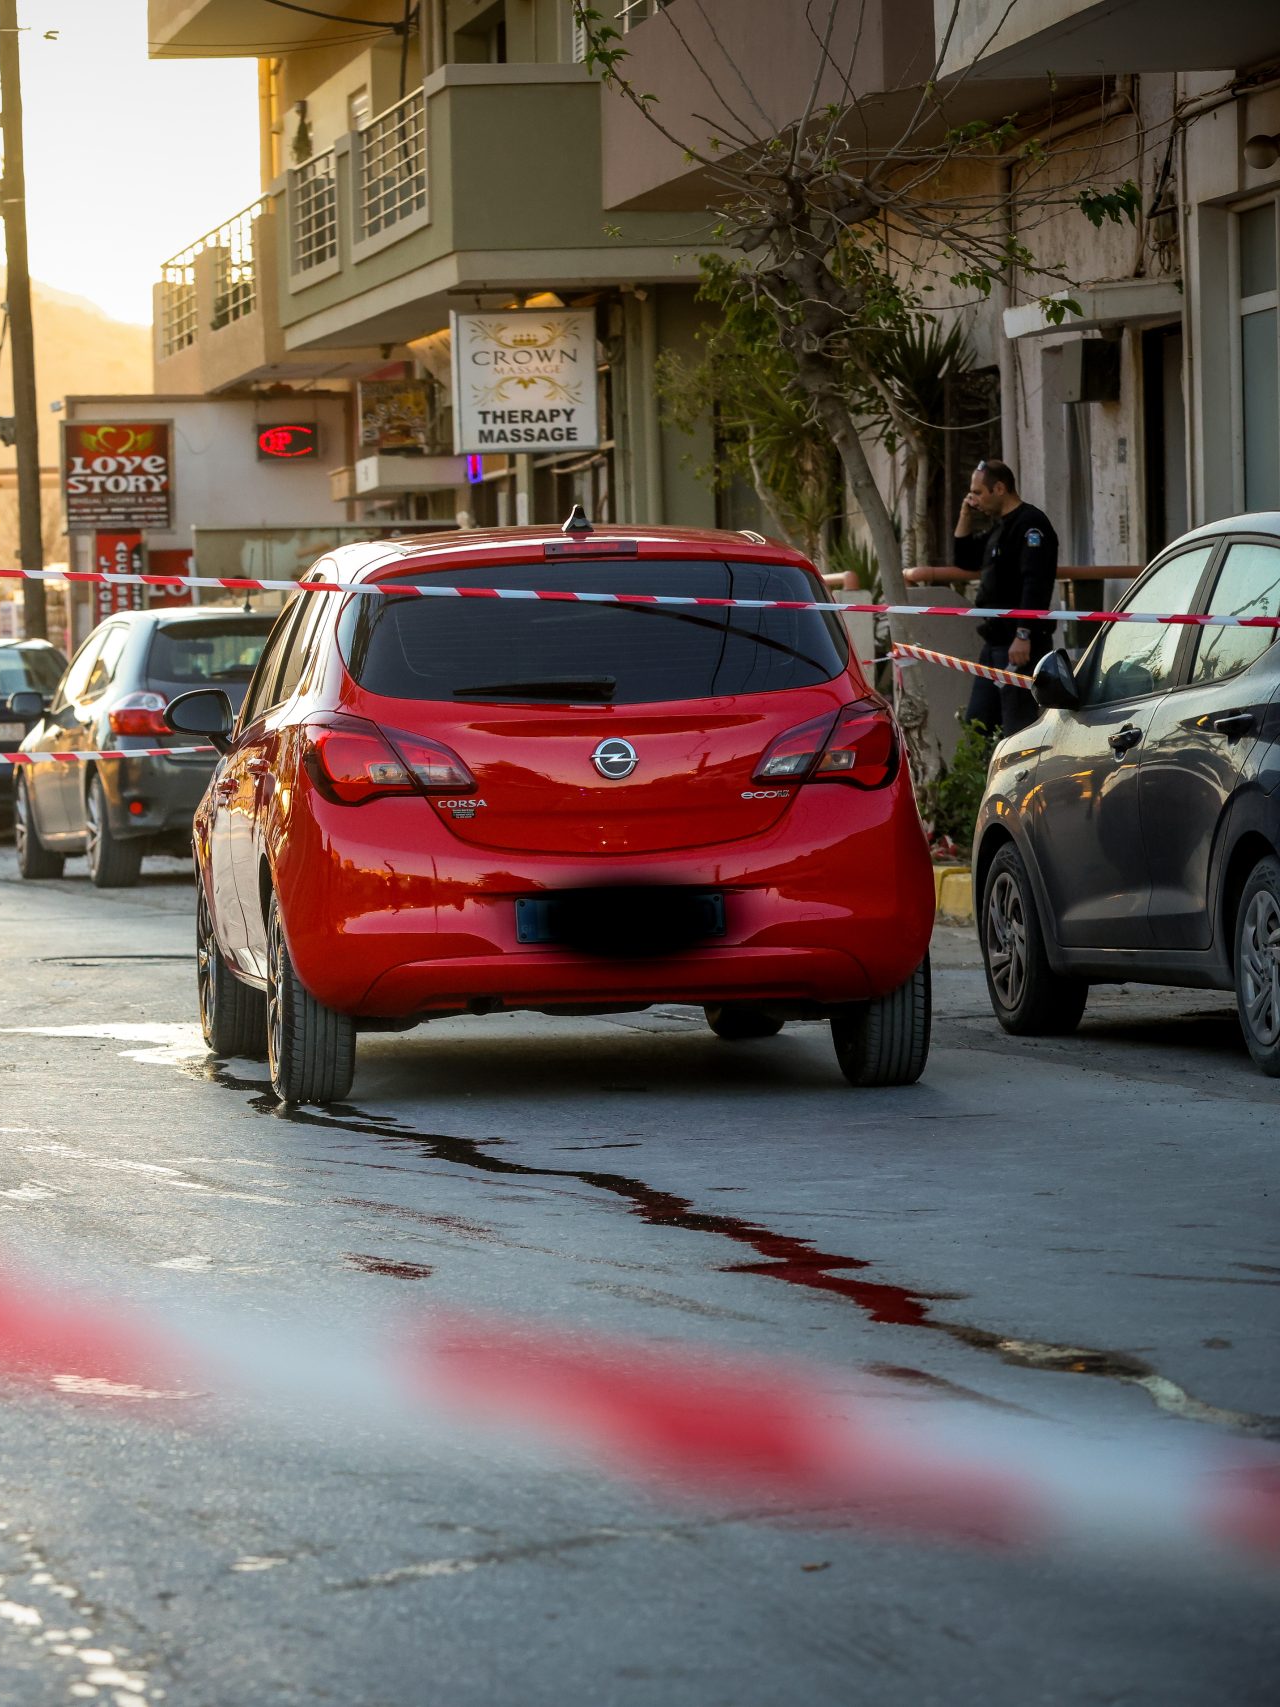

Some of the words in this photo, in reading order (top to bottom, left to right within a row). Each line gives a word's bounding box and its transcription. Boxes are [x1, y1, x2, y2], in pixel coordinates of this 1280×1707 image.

[471, 349, 577, 366] CROWN
[493, 365, 561, 375] MASSAGE
[478, 408, 575, 425] THERAPY
[478, 427, 578, 444] MASSAGE
[67, 475, 168, 494] STORY
[437, 799, 488, 809] CORSA
